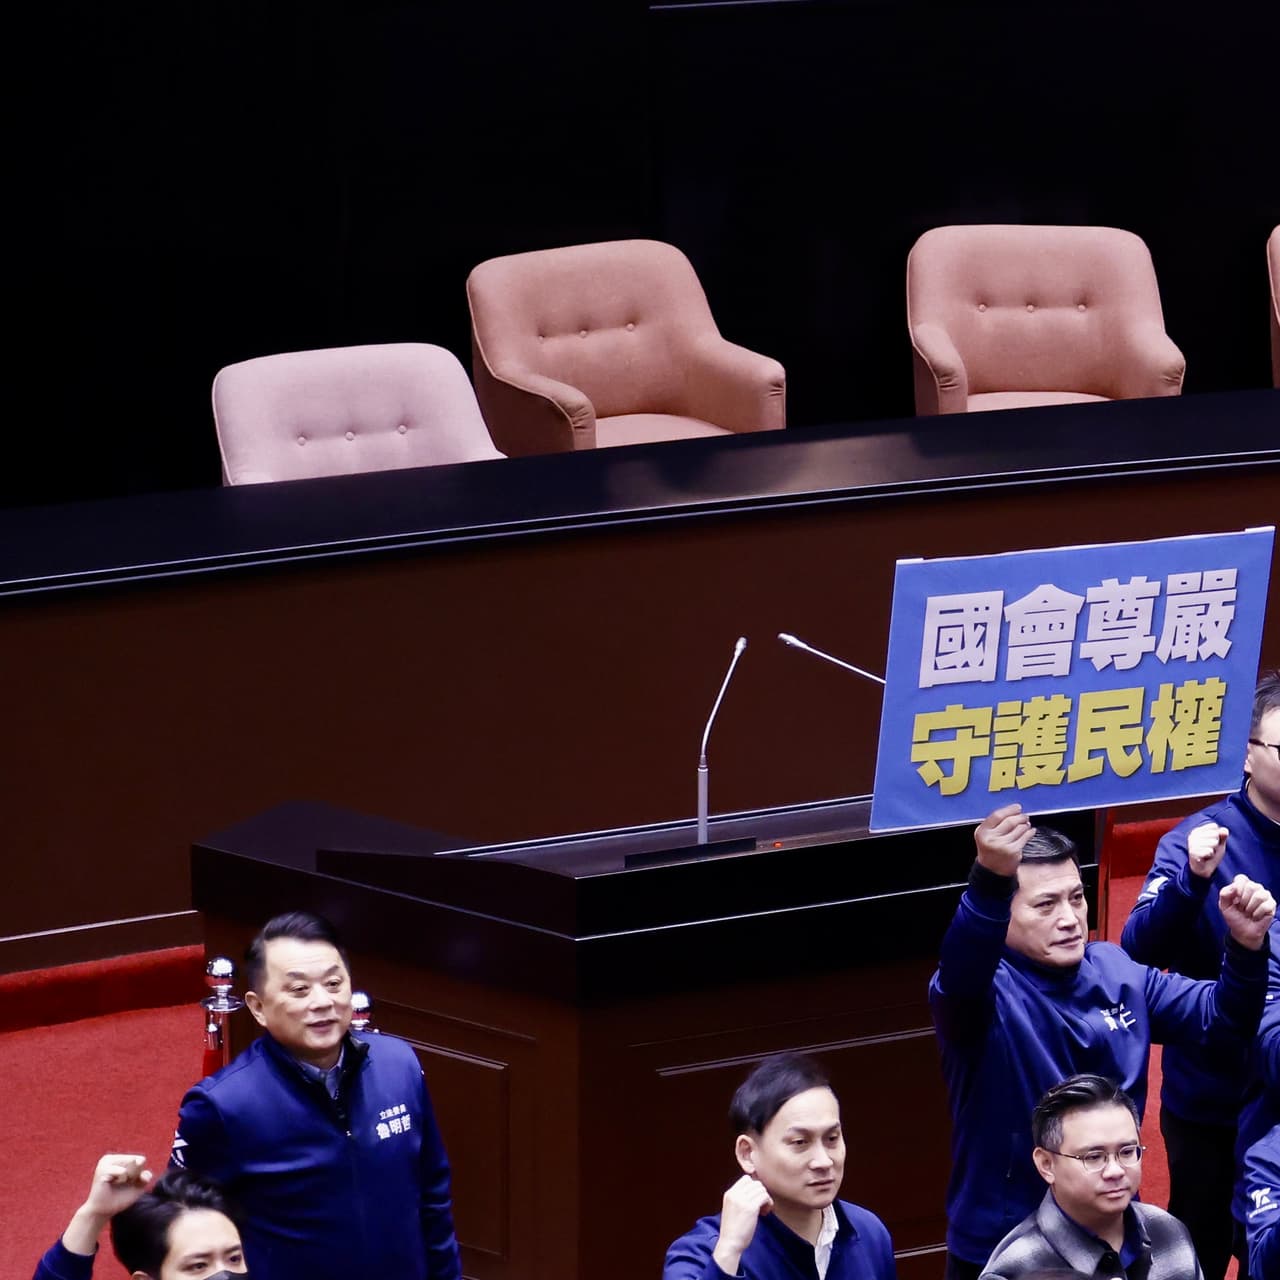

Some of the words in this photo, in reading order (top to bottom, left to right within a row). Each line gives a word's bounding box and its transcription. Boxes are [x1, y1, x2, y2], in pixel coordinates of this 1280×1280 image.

[919, 568, 1237, 688] 國會尊嚴
[911, 677, 1226, 796] 守護民權
